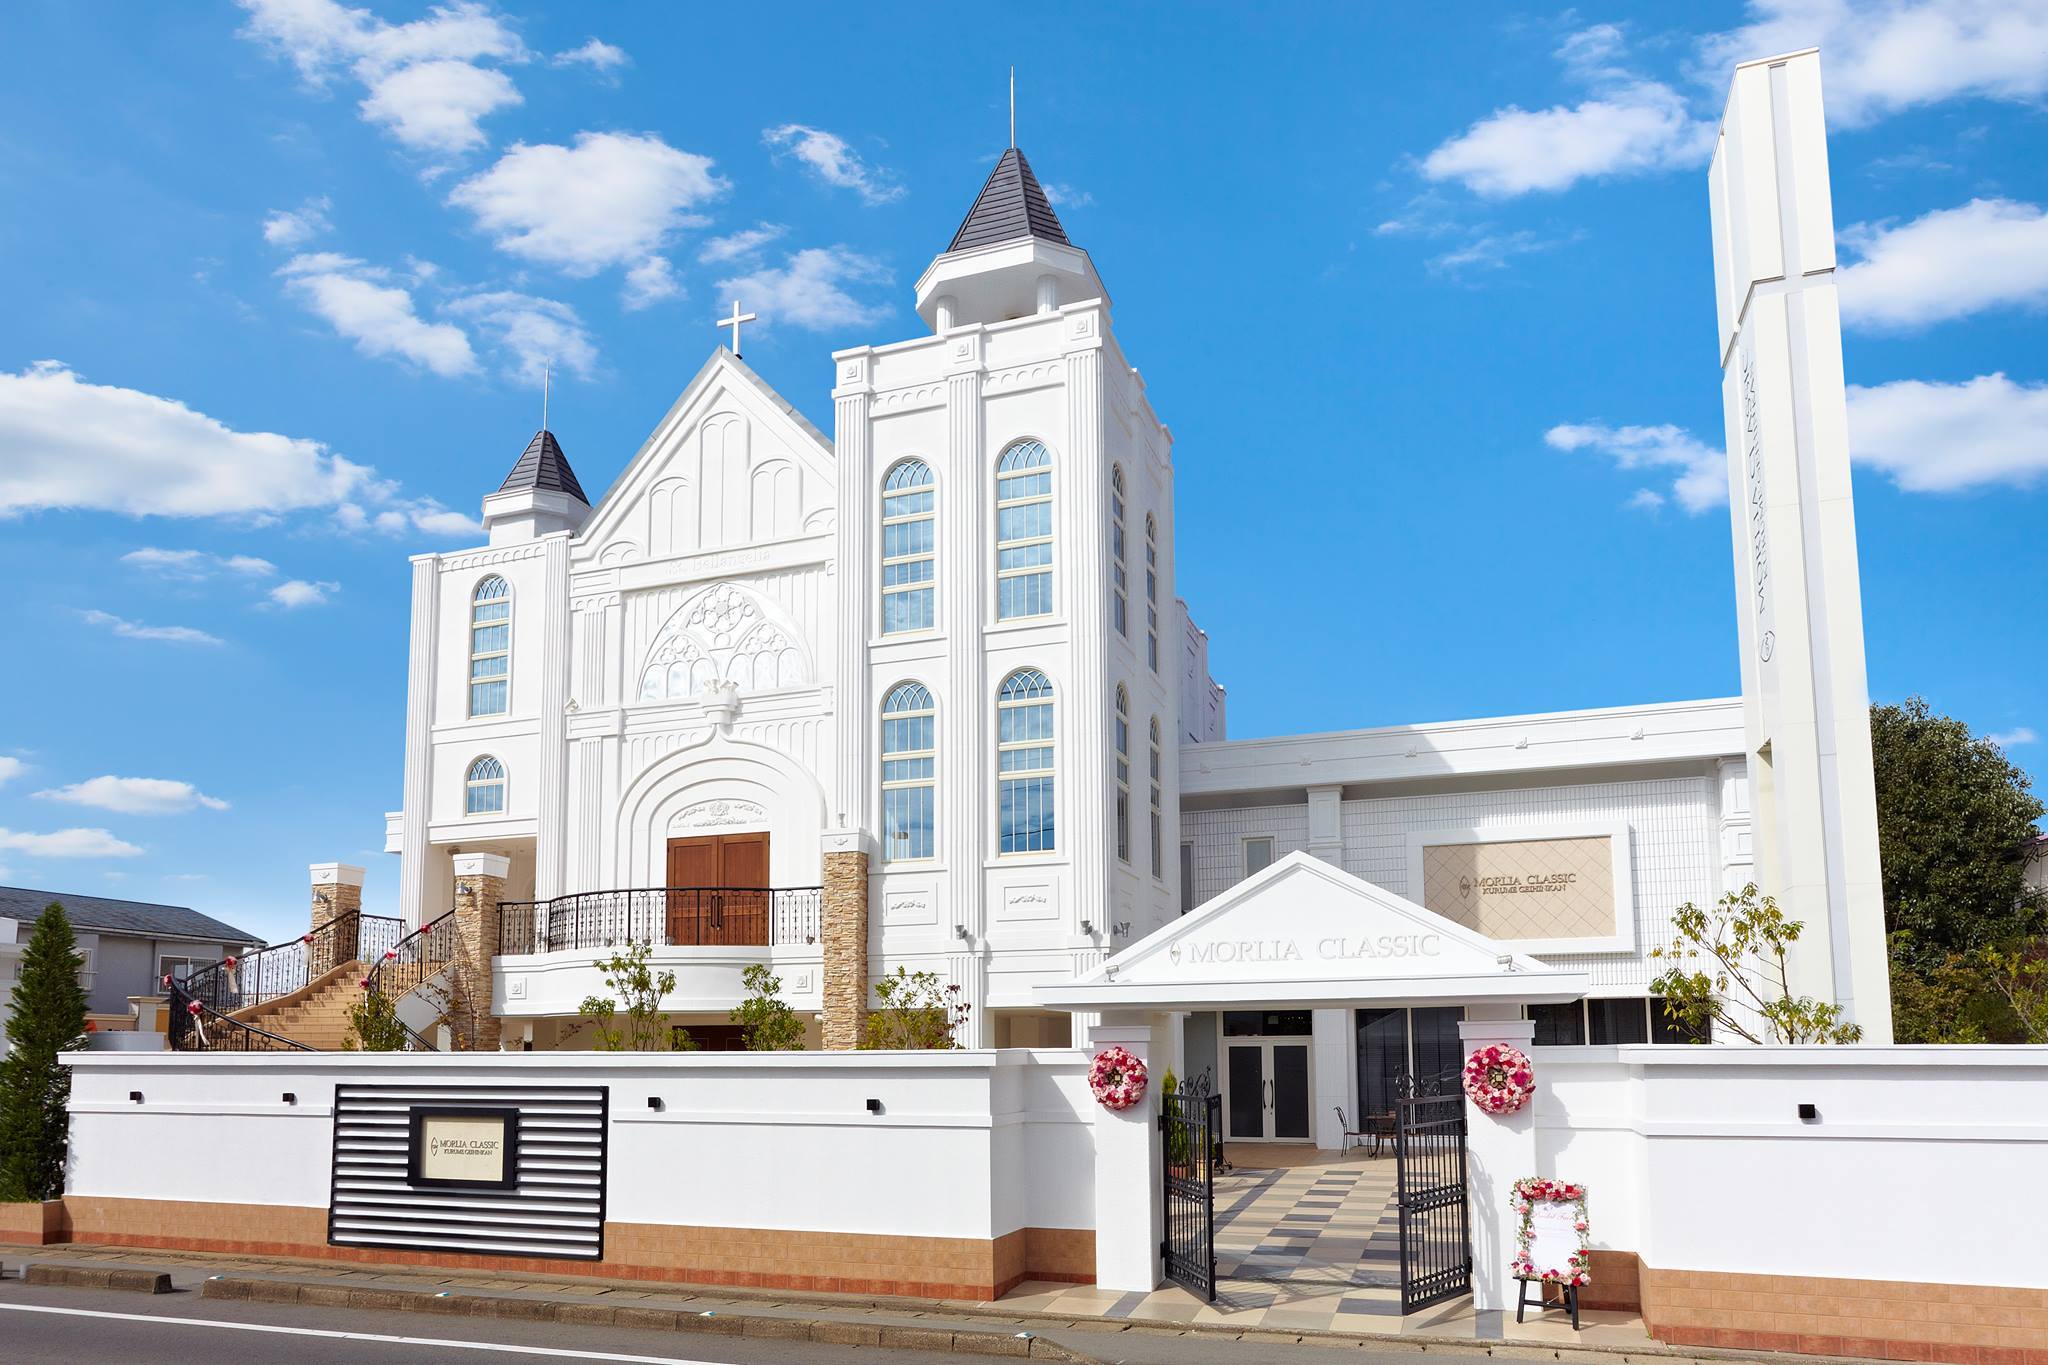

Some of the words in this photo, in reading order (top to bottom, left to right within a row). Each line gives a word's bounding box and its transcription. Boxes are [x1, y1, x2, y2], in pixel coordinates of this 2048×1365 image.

[1473, 876, 1522, 887] MORLIA
[1527, 873, 1577, 885] CLASSIC
[1189, 940, 1304, 963] MORLIA
[1318, 934, 1441, 959] CLASSIC
[440, 1140, 467, 1148] MORLIA
[470, 1141, 499, 1149] CLASSIC
